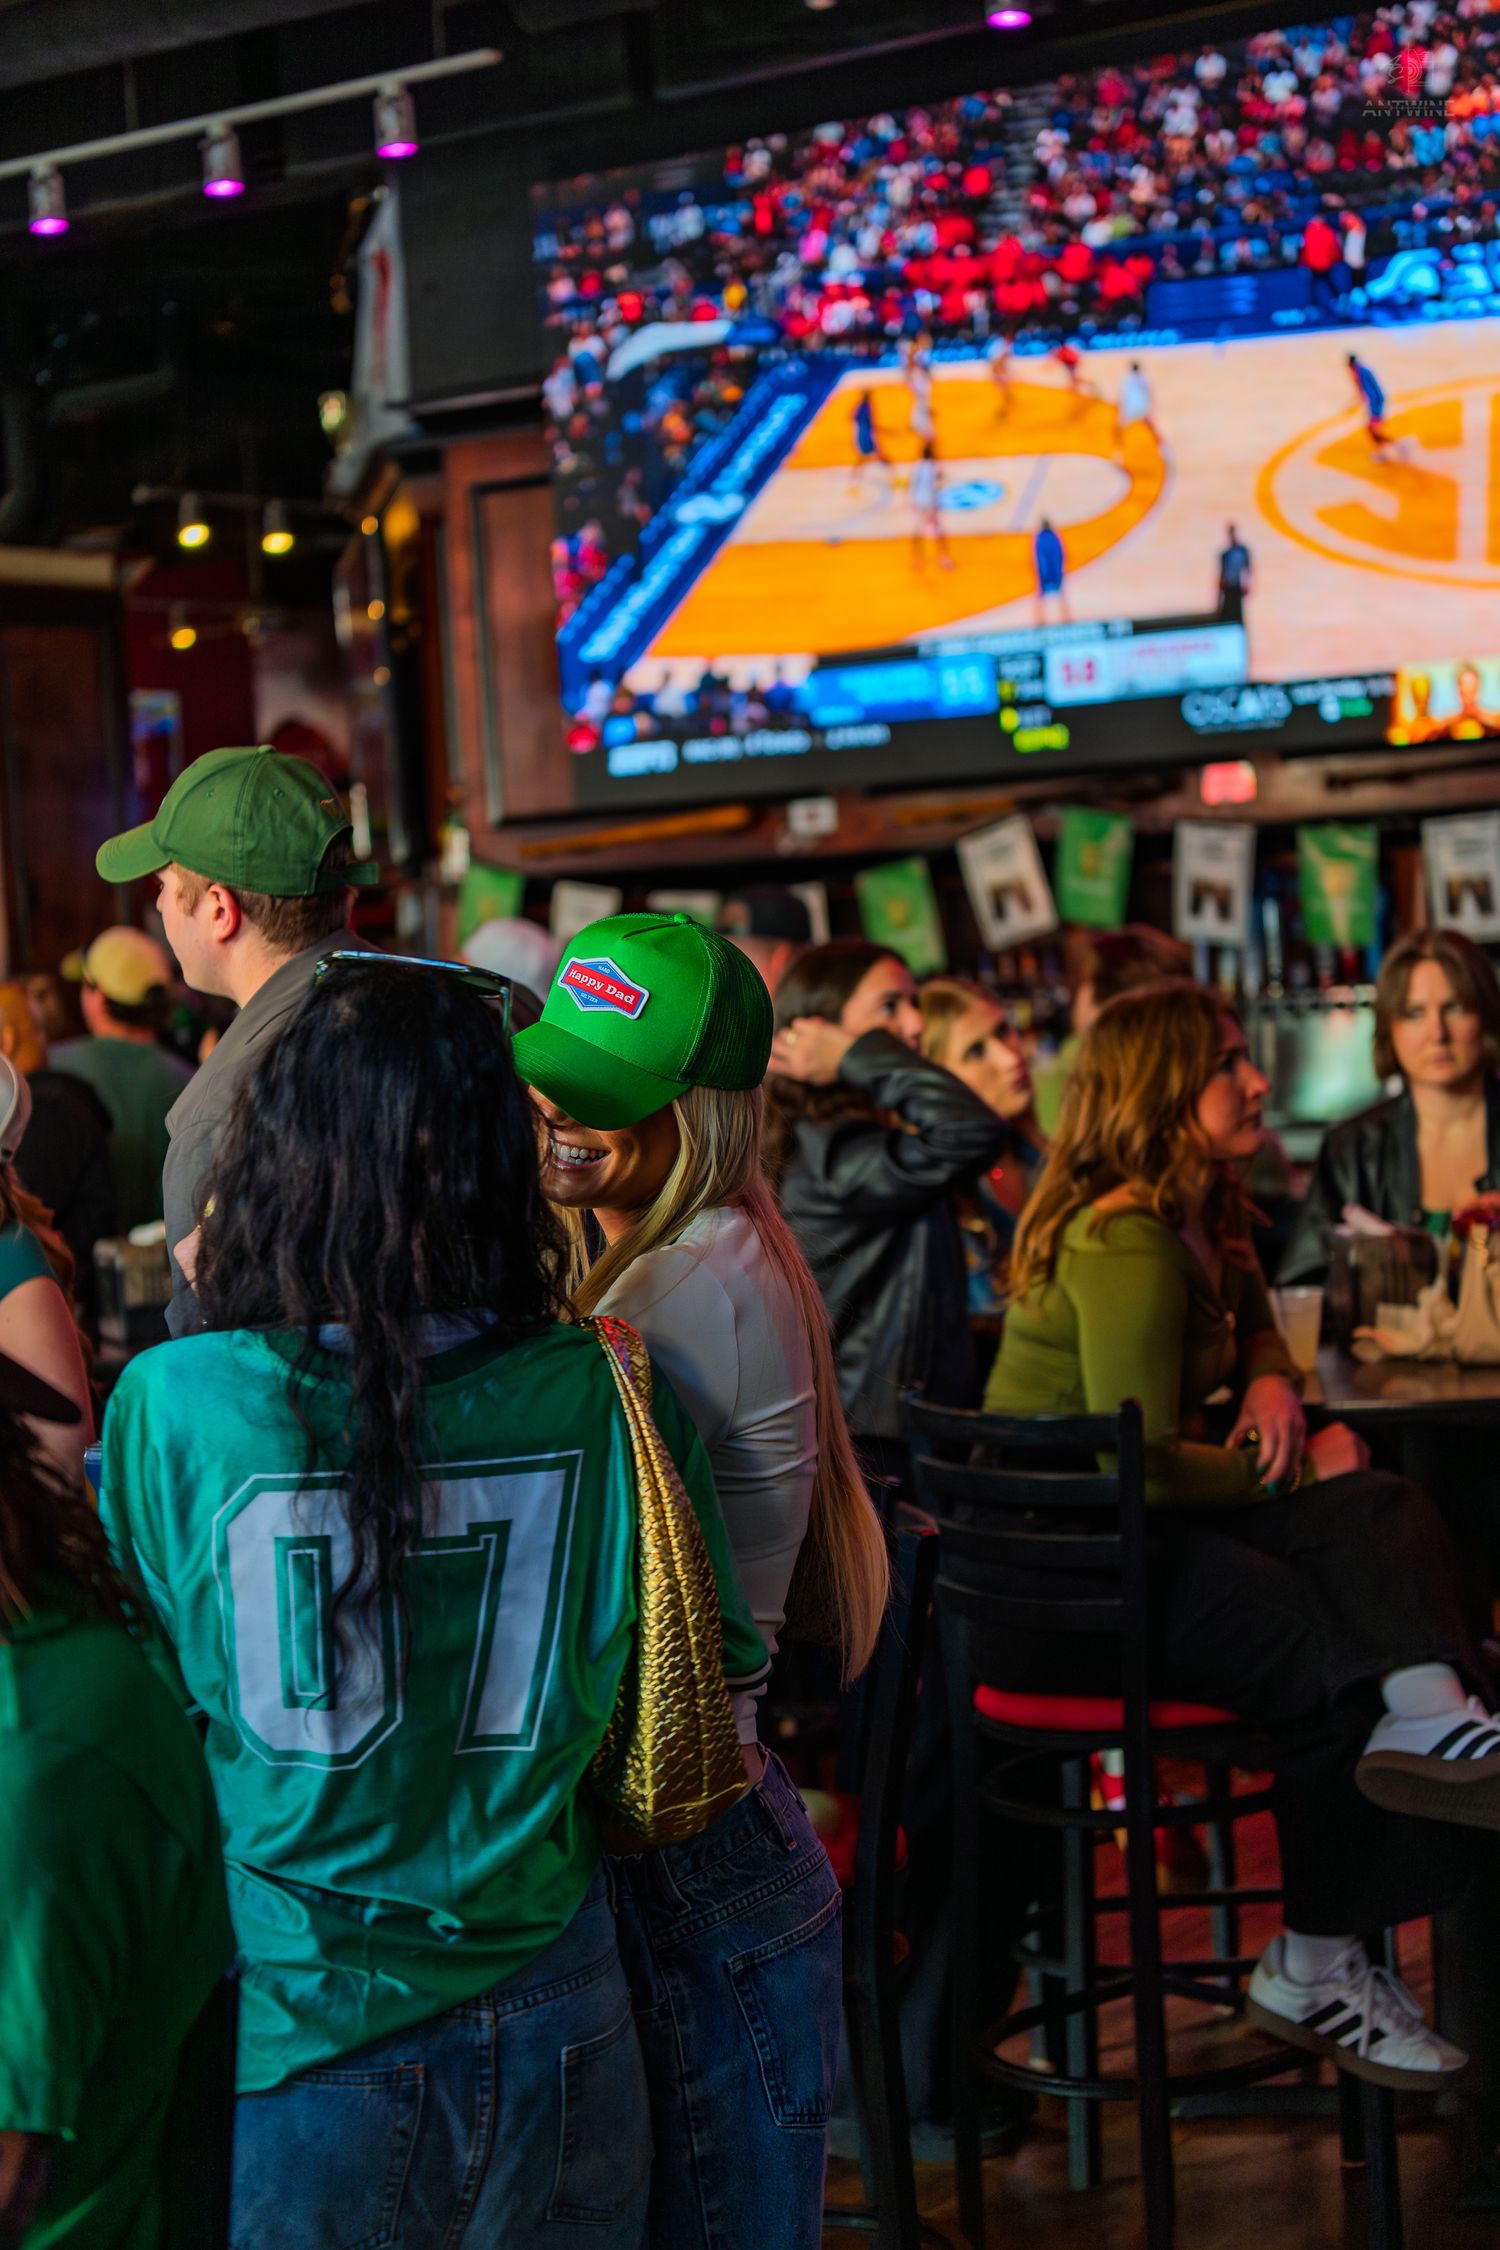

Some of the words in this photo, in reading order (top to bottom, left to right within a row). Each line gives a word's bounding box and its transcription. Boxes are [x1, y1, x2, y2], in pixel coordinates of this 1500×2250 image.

[568, 969, 604, 990] Happy
[605, 984, 635, 1005] Dad
[212, 1449, 585, 1772] 07
